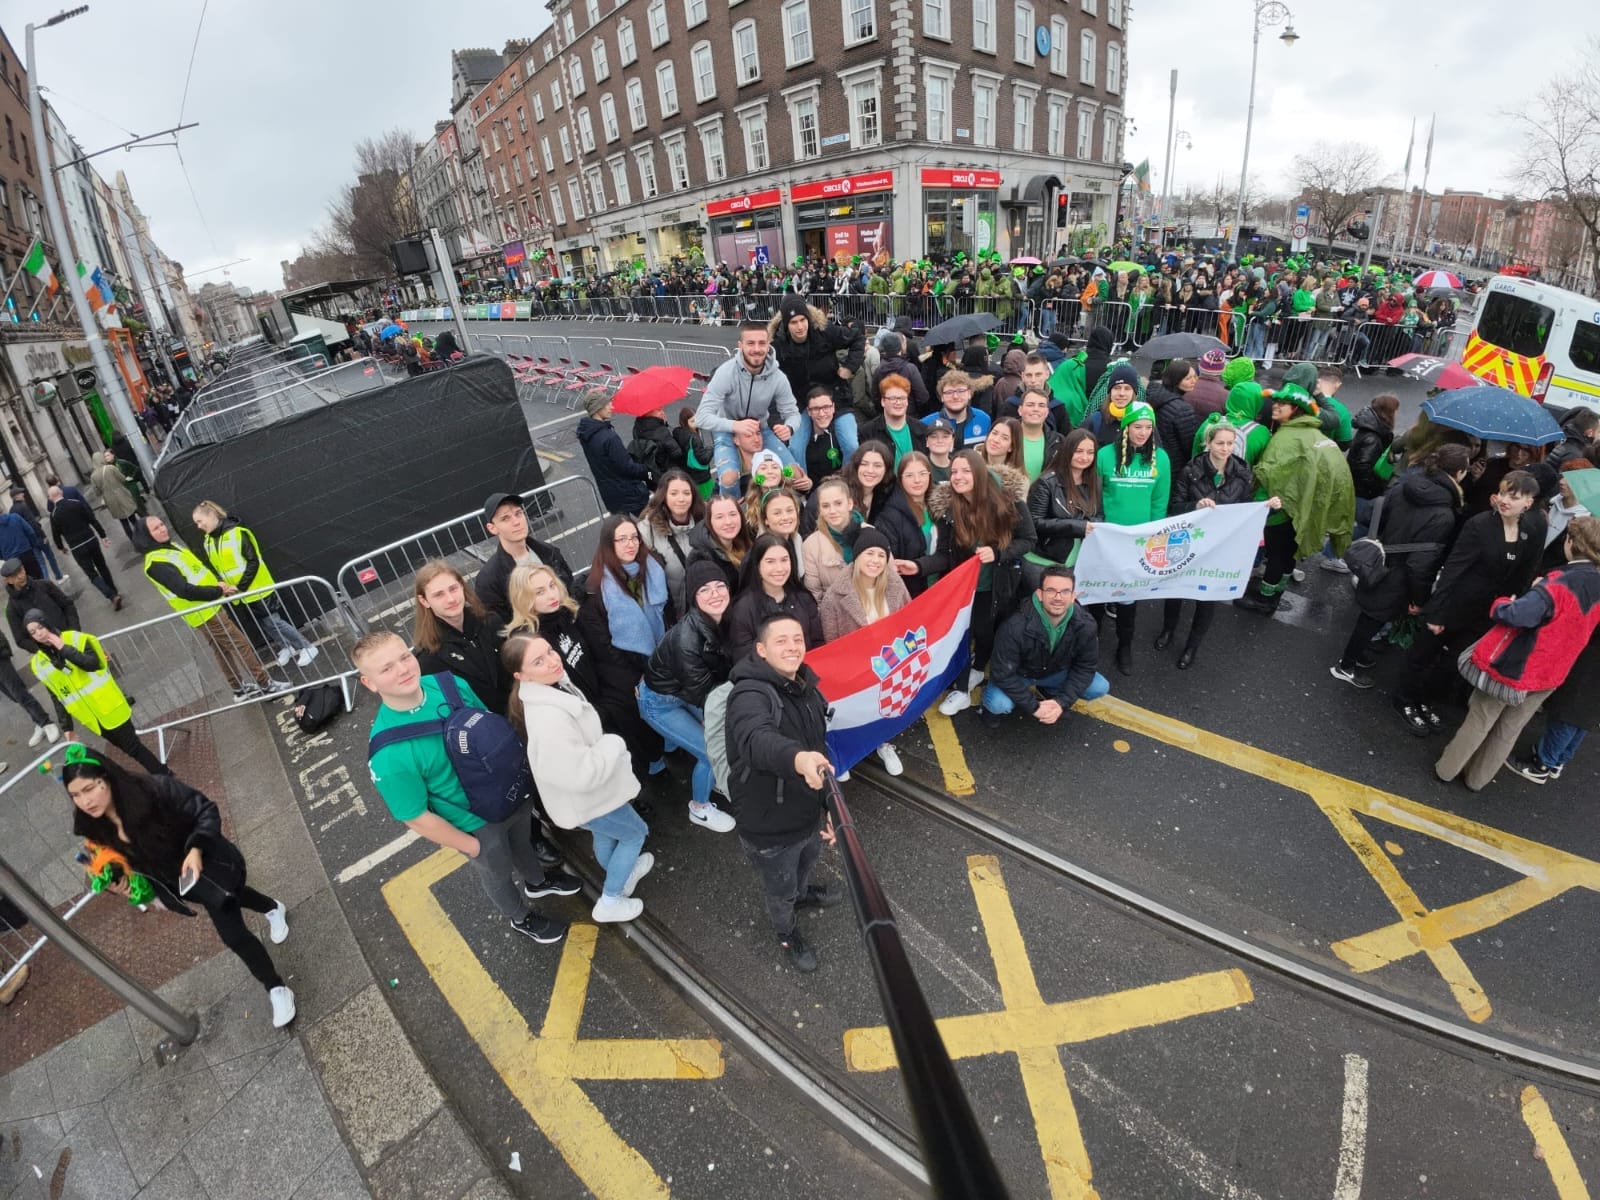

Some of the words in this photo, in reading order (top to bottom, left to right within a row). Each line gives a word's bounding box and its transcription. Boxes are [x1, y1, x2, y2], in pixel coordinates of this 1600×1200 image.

[952, 174, 968, 183] CIRCLE
[823, 183, 842, 193] CIRCLE
[841, 179, 851, 193] K
[1494, 282, 1516, 294] GARDA
[1138, 557, 1156, 576] ŠKOLA
[1158, 552, 1196, 576] BJELOVAR
[1199, 567, 1242, 579] Ireland
[298, 751, 369, 833] LEFT
